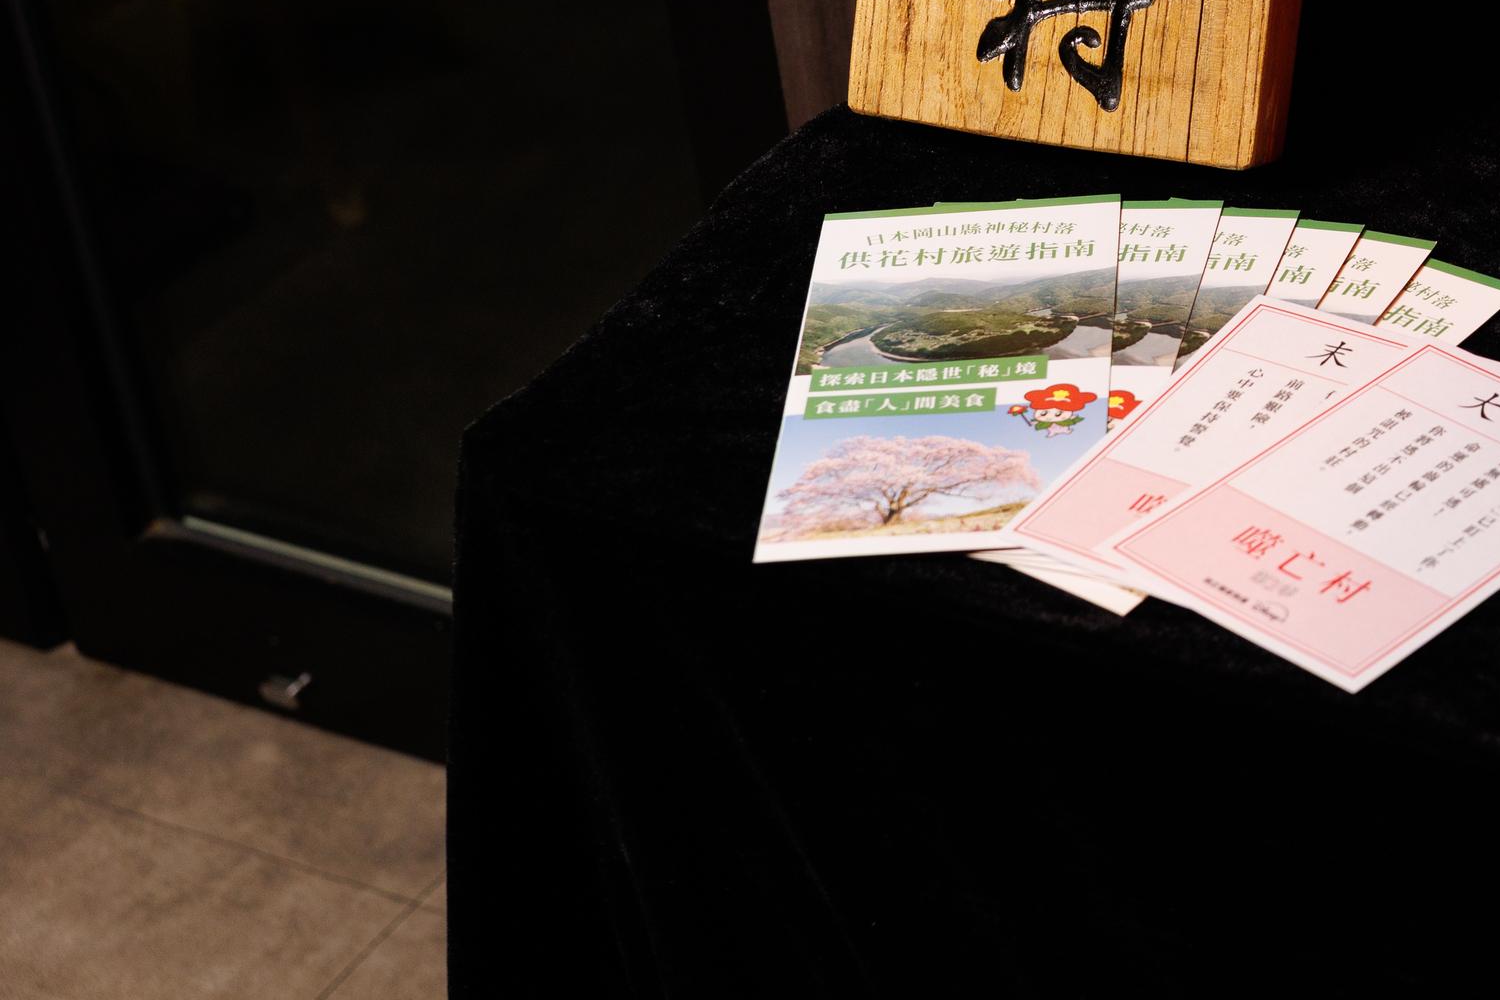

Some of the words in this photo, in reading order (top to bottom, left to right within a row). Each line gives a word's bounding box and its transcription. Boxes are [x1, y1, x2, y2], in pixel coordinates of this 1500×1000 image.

[1212, 231, 1248, 247] 落
[838, 239, 1097, 270] 供花村旅遊指南
[1278, 265, 1316, 285] 南
